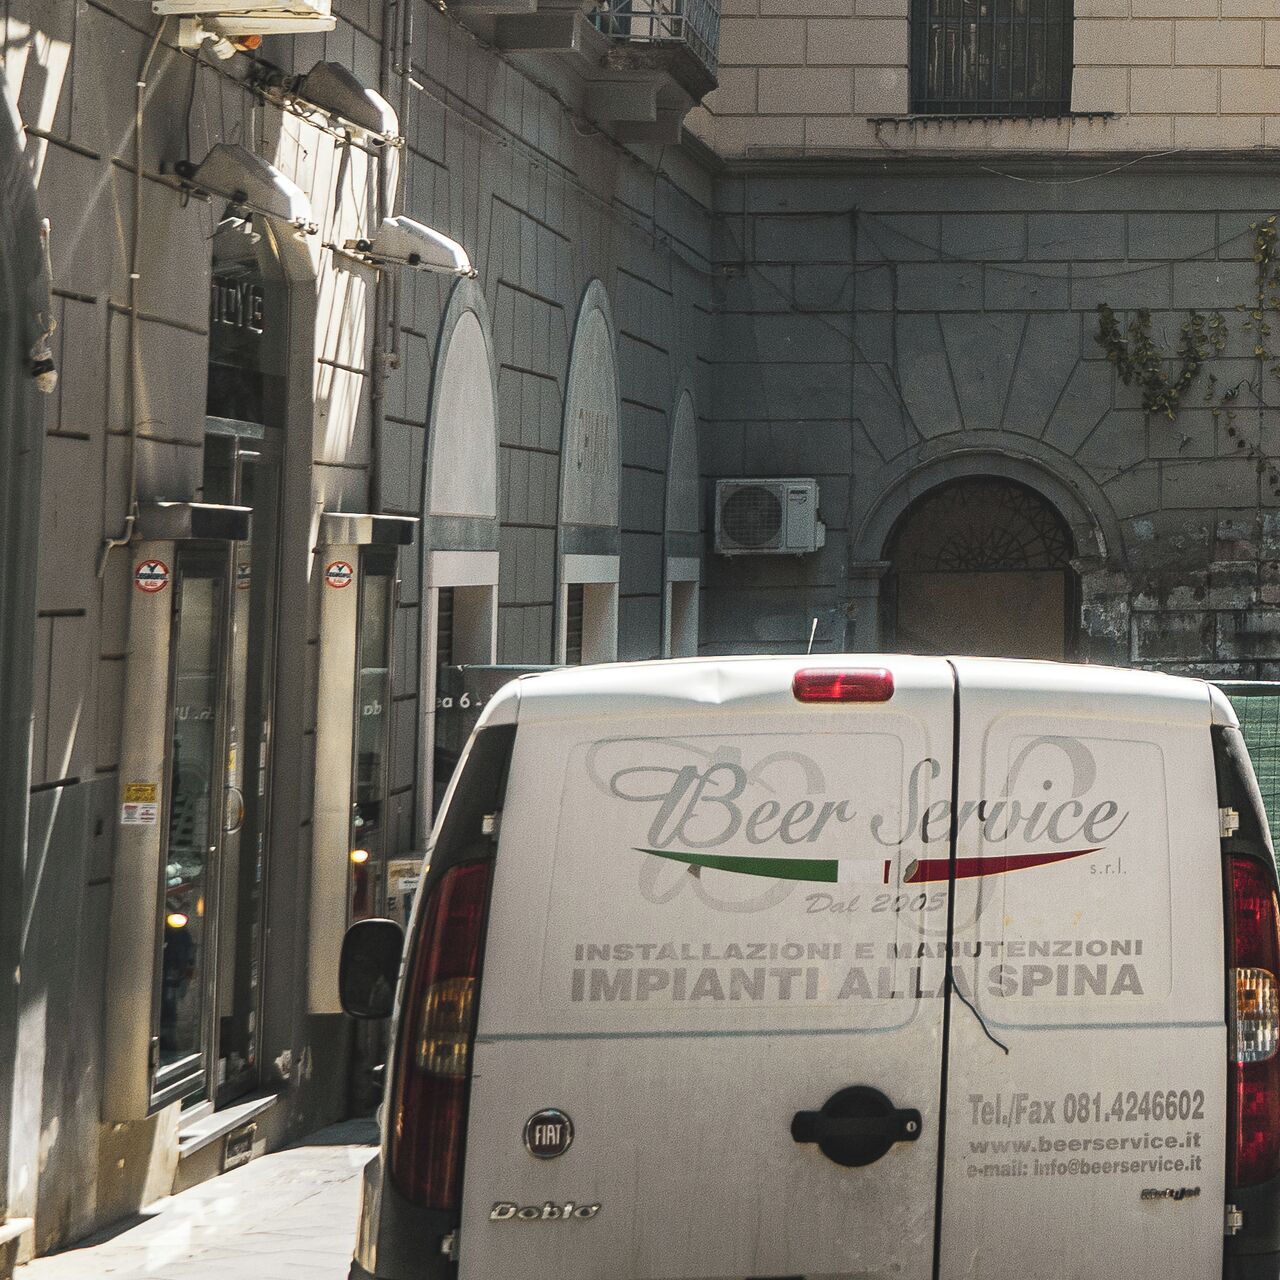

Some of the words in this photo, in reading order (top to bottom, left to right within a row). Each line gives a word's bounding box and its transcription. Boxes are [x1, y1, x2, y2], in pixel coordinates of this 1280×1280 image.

[610, 762, 857, 848] Beer
[870, 757, 1130, 847] Service
[1090, 857, 1127, 875] s.r.l.
[804, 892, 860, 913] Dal
[871, 891, 948, 913] 2005
[574, 942, 842, 961] INSTALLAZIONI
[855, 942, 874, 959] E
[886, 939, 1144, 959] MANUTENZIONI
[571, 966, 819, 1001] IMPIANTI
[838, 965, 973, 999] ALLA
[986, 962, 1145, 997] SPINA
[968, 1093, 1056, 1128] Tel./Fax
[1063, 1089, 1205, 1124] 081.4246602
[535, 1124, 562, 1145] FIAT
[968, 1132, 1202, 1154] www.beerservice.it
[967, 1159, 1029, 1178] e-mail:
[1033, 1154, 1203, 1177] info@beerservice.it
